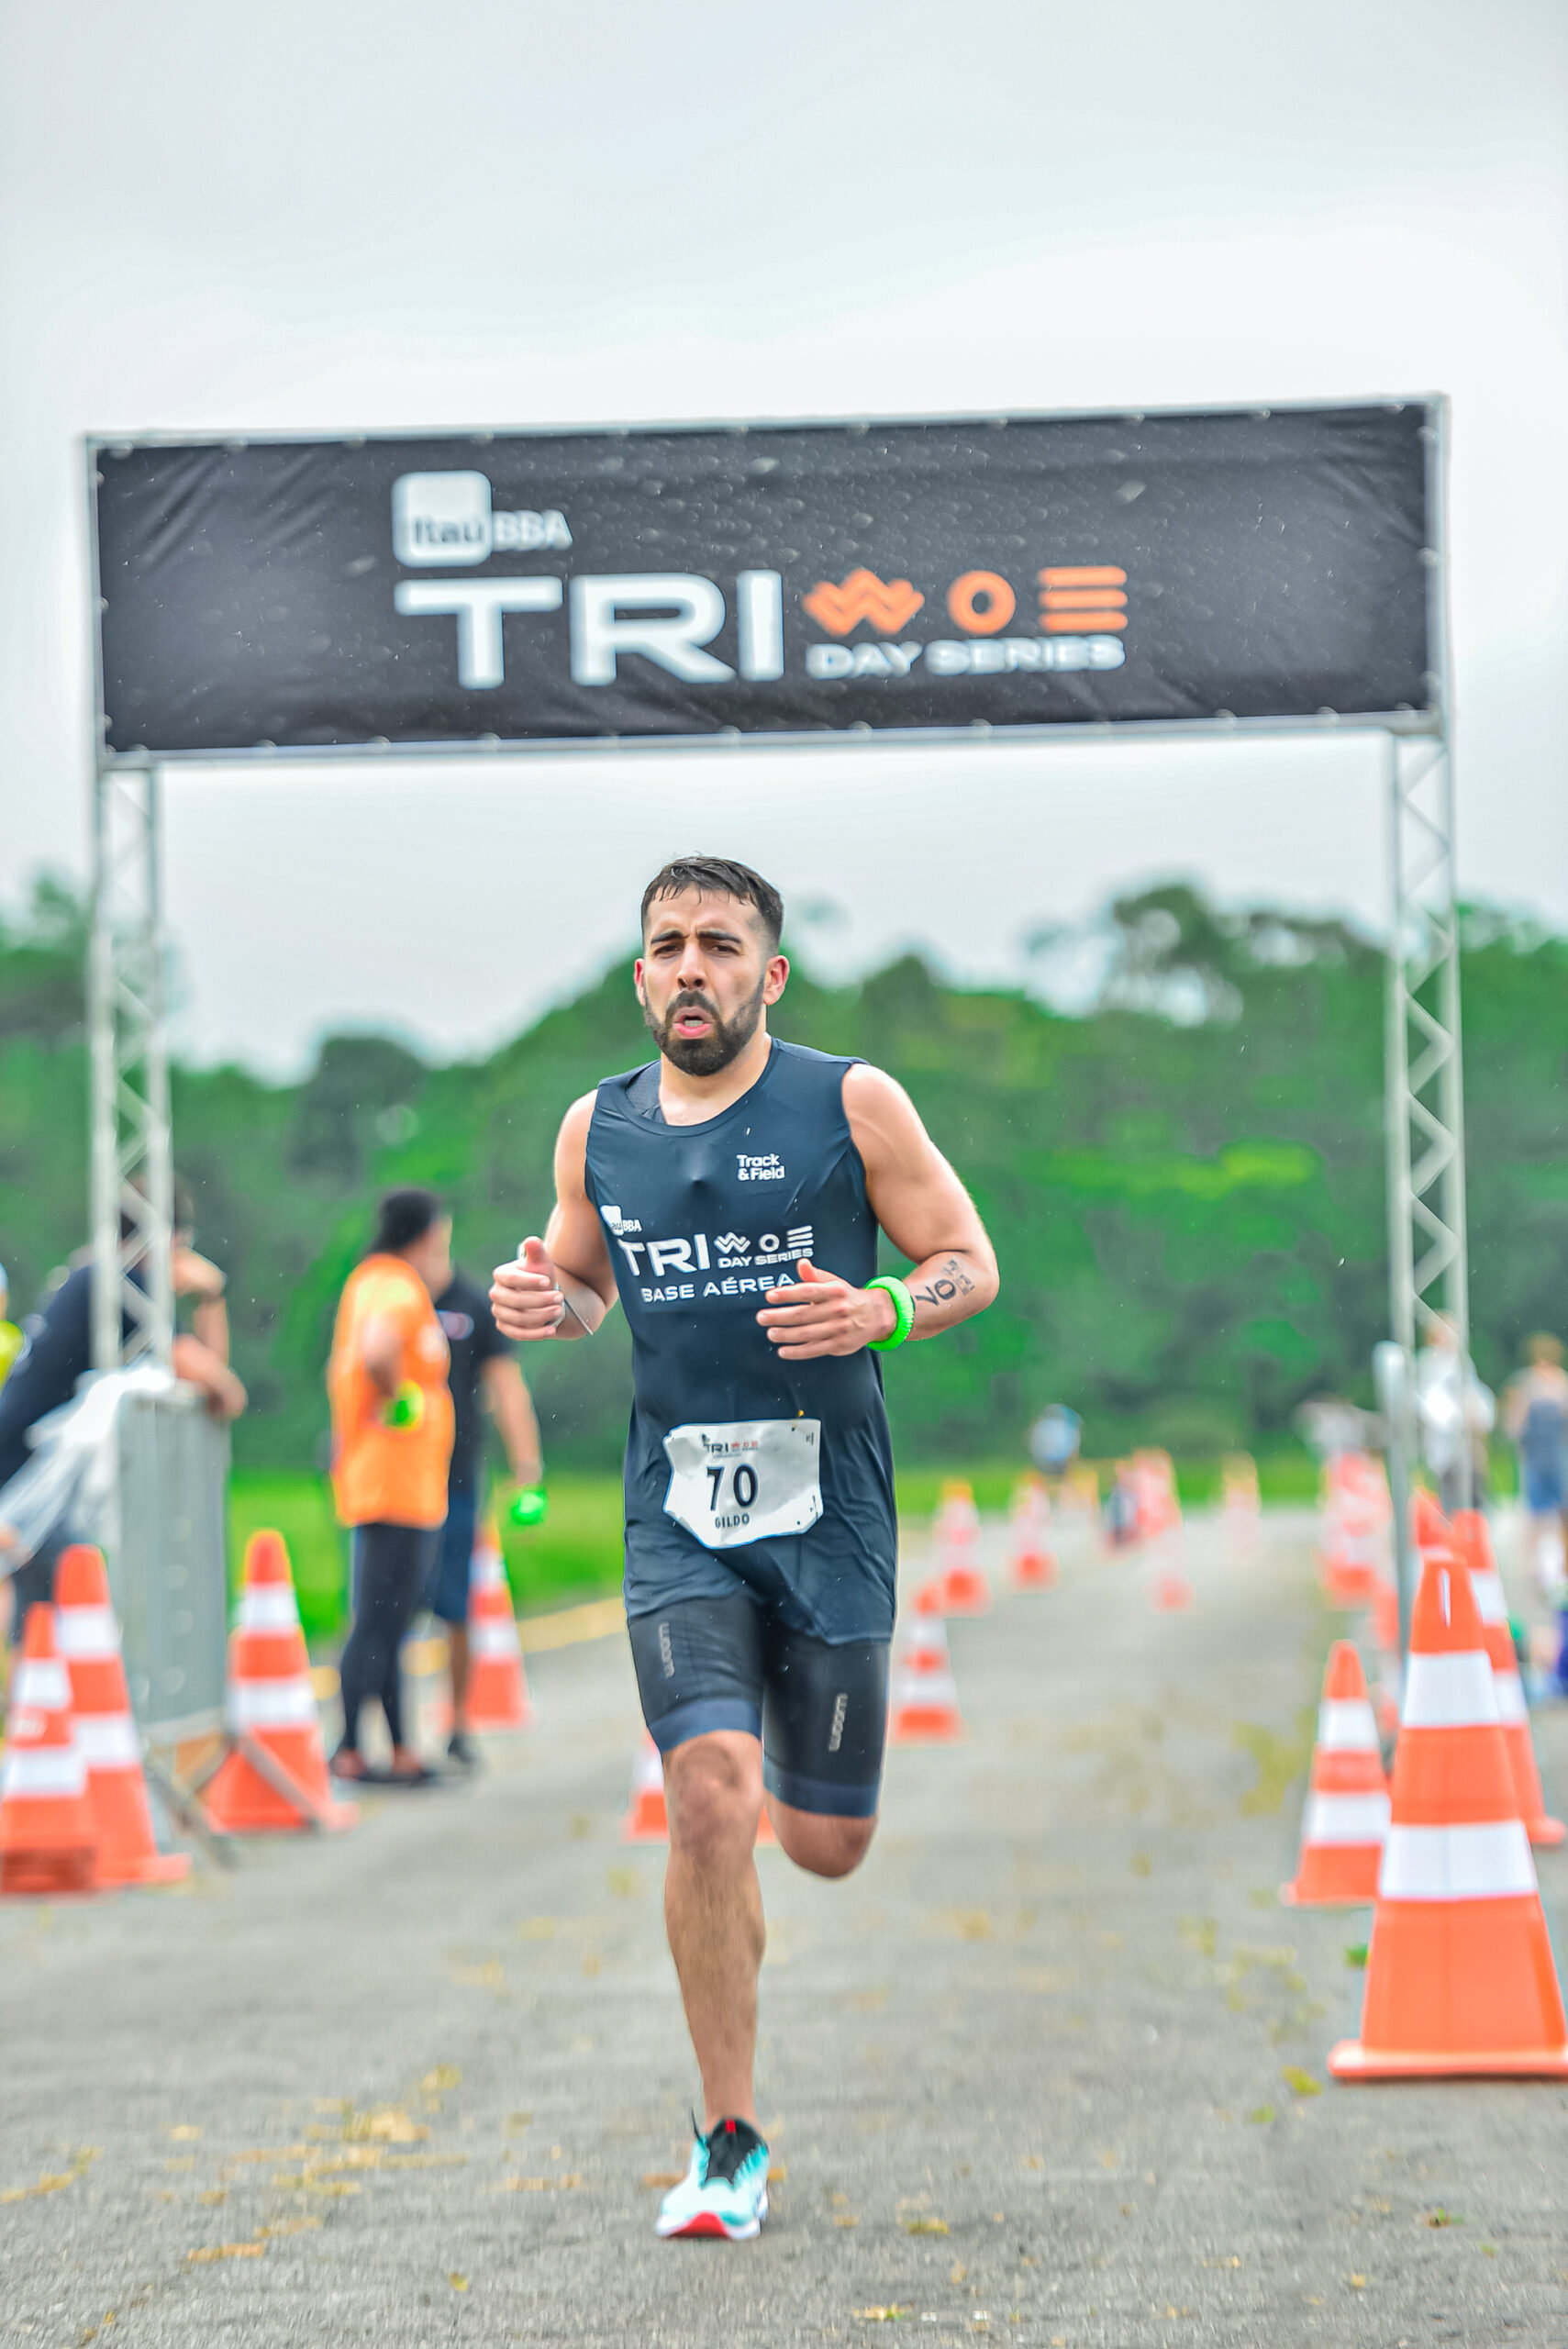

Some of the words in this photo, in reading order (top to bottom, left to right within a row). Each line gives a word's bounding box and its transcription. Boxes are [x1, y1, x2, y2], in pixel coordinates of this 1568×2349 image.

[492, 509, 573, 551] BBA
[394, 569, 784, 690] TRI
[805, 641, 923, 680] DAY
[925, 635, 1126, 676] SERIES
[736, 1152, 780, 1167] Track
[737, 1167, 750, 1181] &
[751, 1165, 785, 1180] Field
[622, 1219, 642, 1232] BBA
[617, 1232, 711, 1277] TRI
[717, 1255, 752, 1268] DAY
[754, 1247, 814, 1265] SERIES
[640, 1284, 695, 1302] BASE
[702, 1273, 795, 1298] AÉREA
[703, 1438, 729, 1453] TRI
[706, 1464, 759, 1512] 70
[715, 1513, 751, 1529] GILDO
